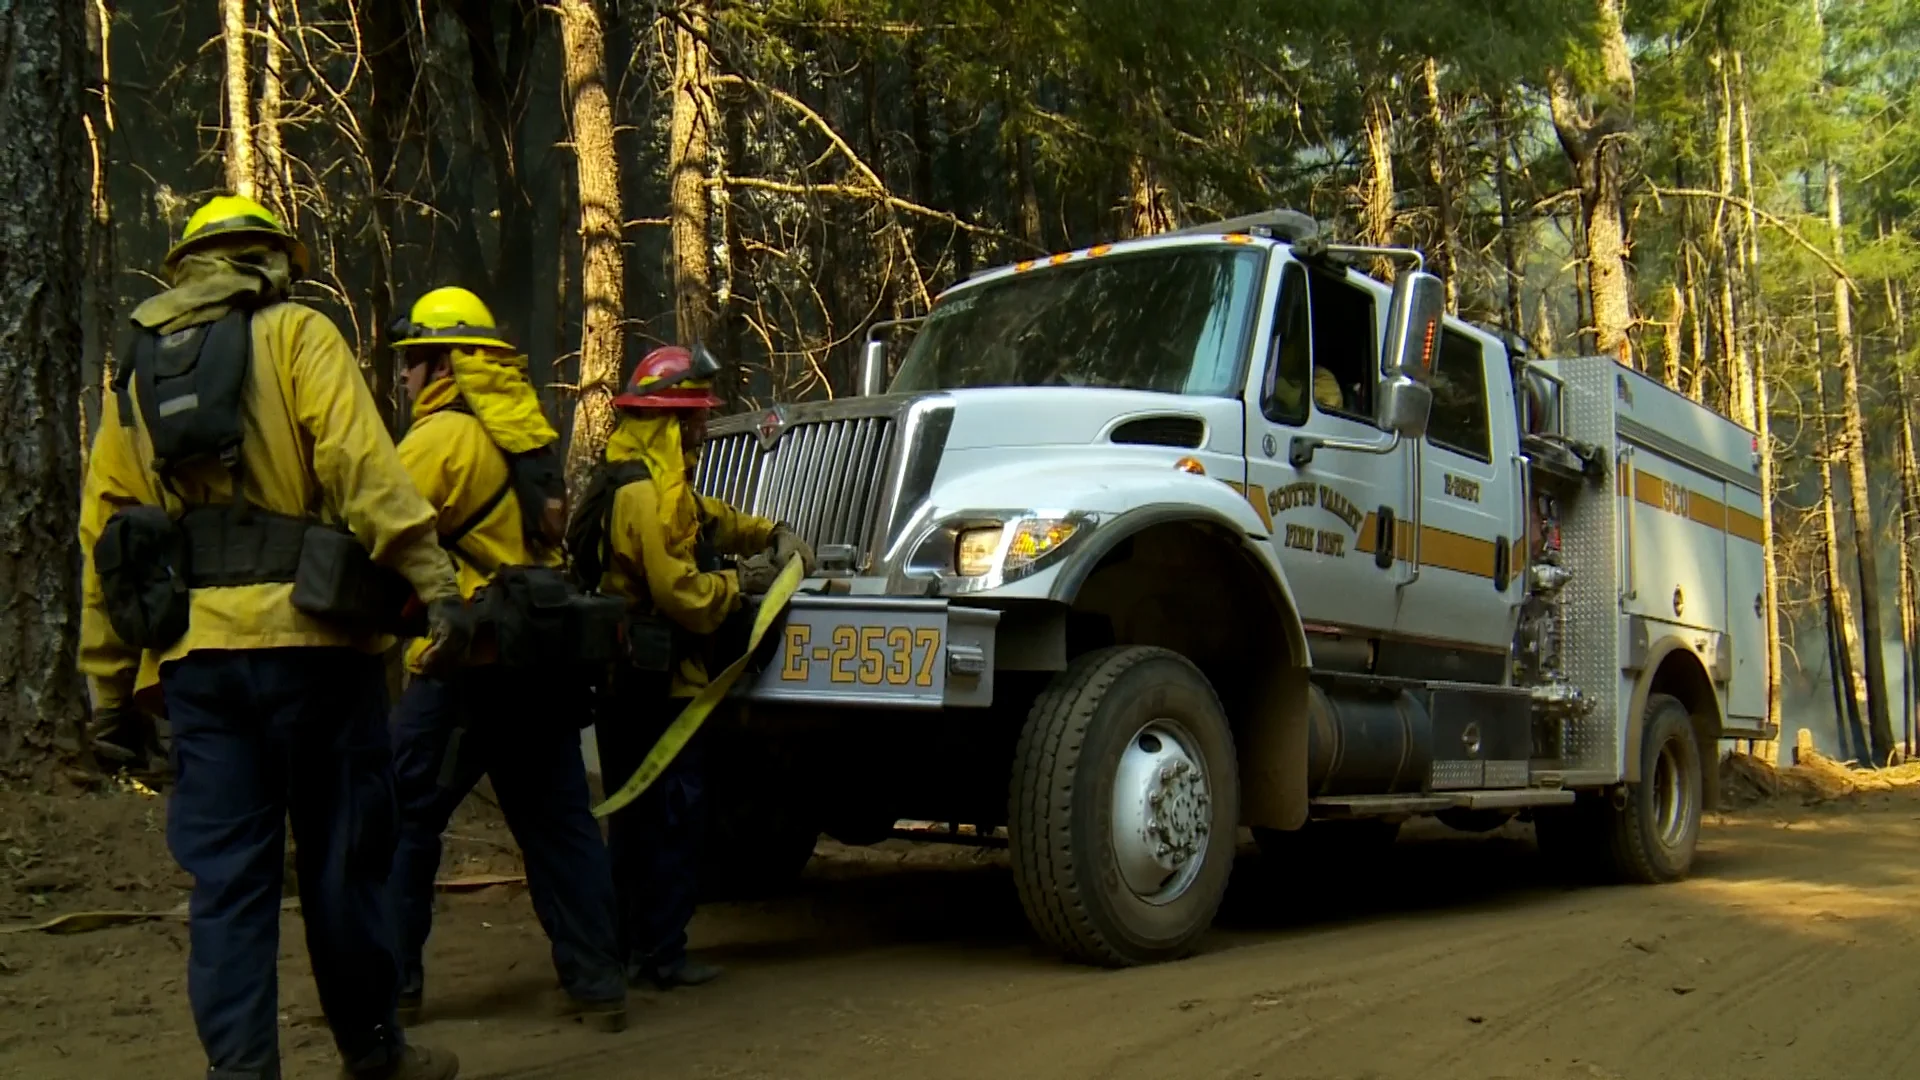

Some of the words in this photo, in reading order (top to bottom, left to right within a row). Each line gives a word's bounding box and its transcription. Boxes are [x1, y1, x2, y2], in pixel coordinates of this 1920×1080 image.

[1268, 482, 1317, 516] SCOTTS
[1320, 484, 1363, 533] VALLEY
[1285, 523, 1315, 551] FIRE
[781, 623, 941, 687] E-2537
